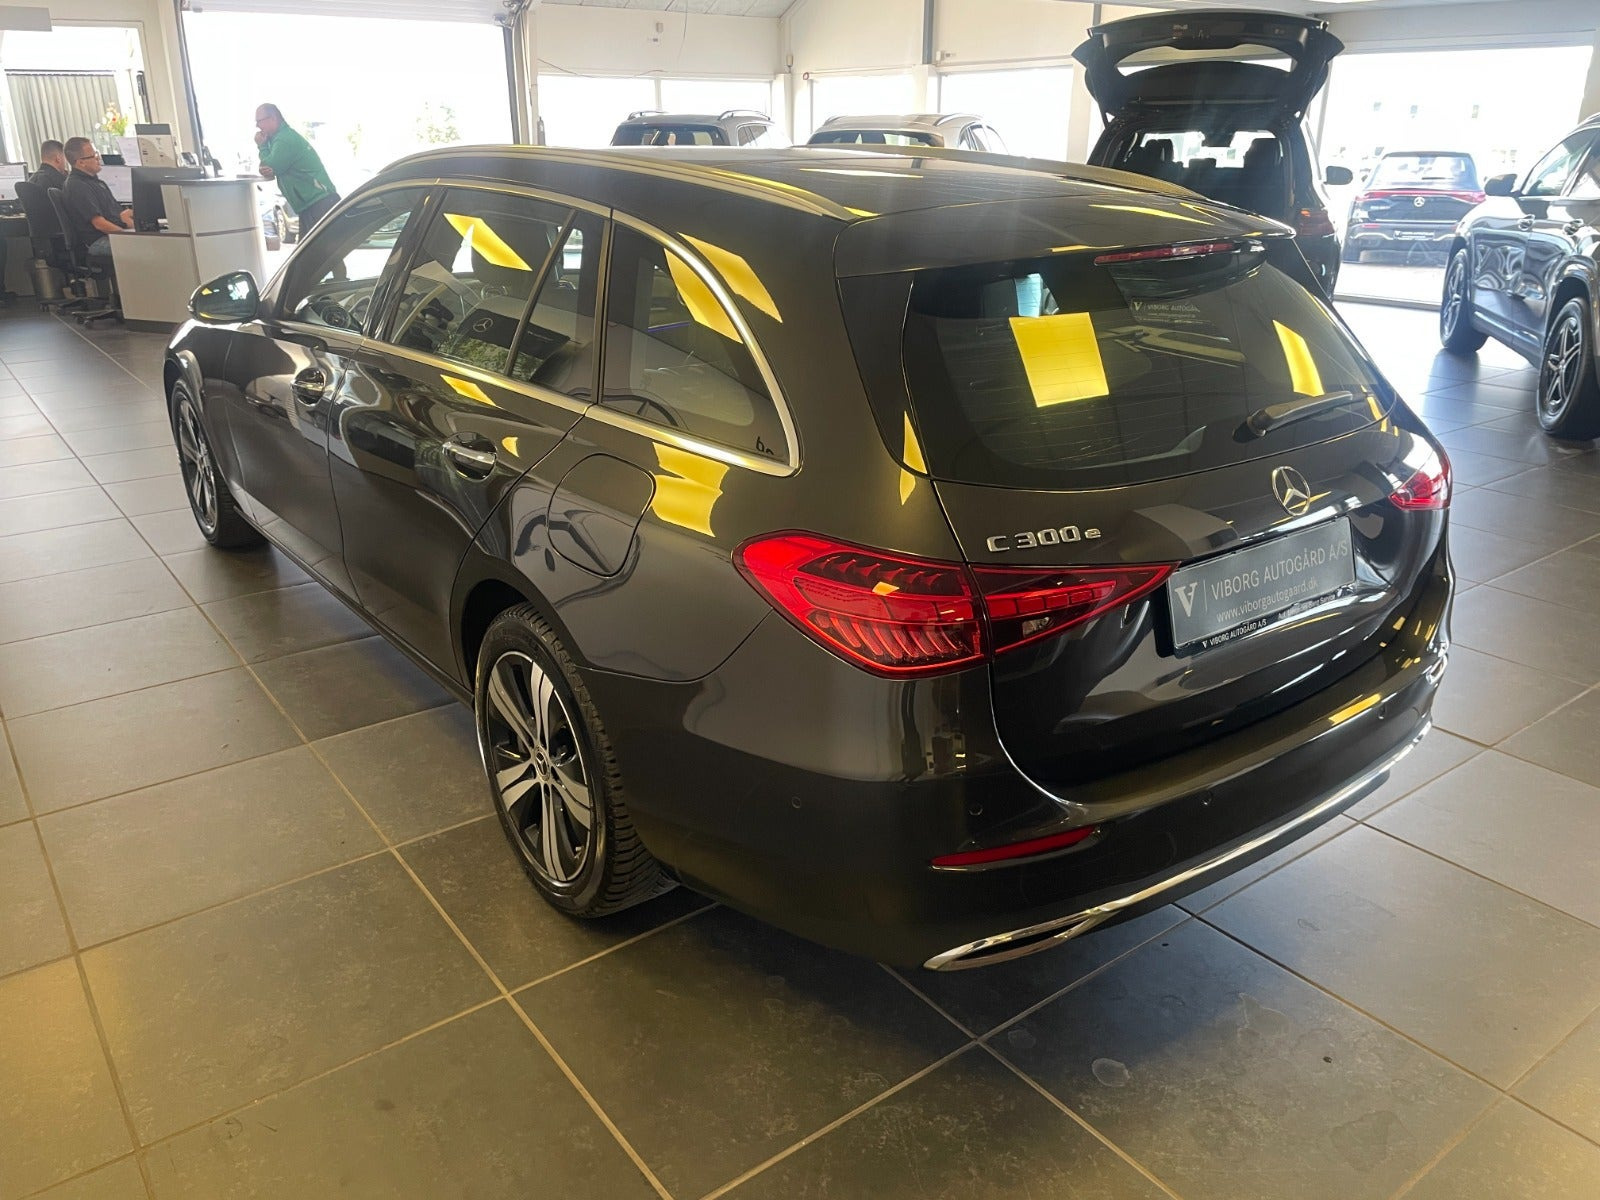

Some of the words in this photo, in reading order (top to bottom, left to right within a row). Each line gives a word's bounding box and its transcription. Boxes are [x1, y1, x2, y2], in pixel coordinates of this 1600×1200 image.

[986, 535, 1010, 552] C
[1211, 569, 1261, 600] VIBORG
[1263, 547, 1326, 584] AUTOGÅRD
[1328, 540, 1348, 561] A/S
[1216, 577, 1318, 623] www.viborgautogaard.dk
[1209, 632, 1230, 646] VIBORG
[1230, 622, 1257, 640] AUTOGÅRD
[1257, 618, 1268, 629] A/S
